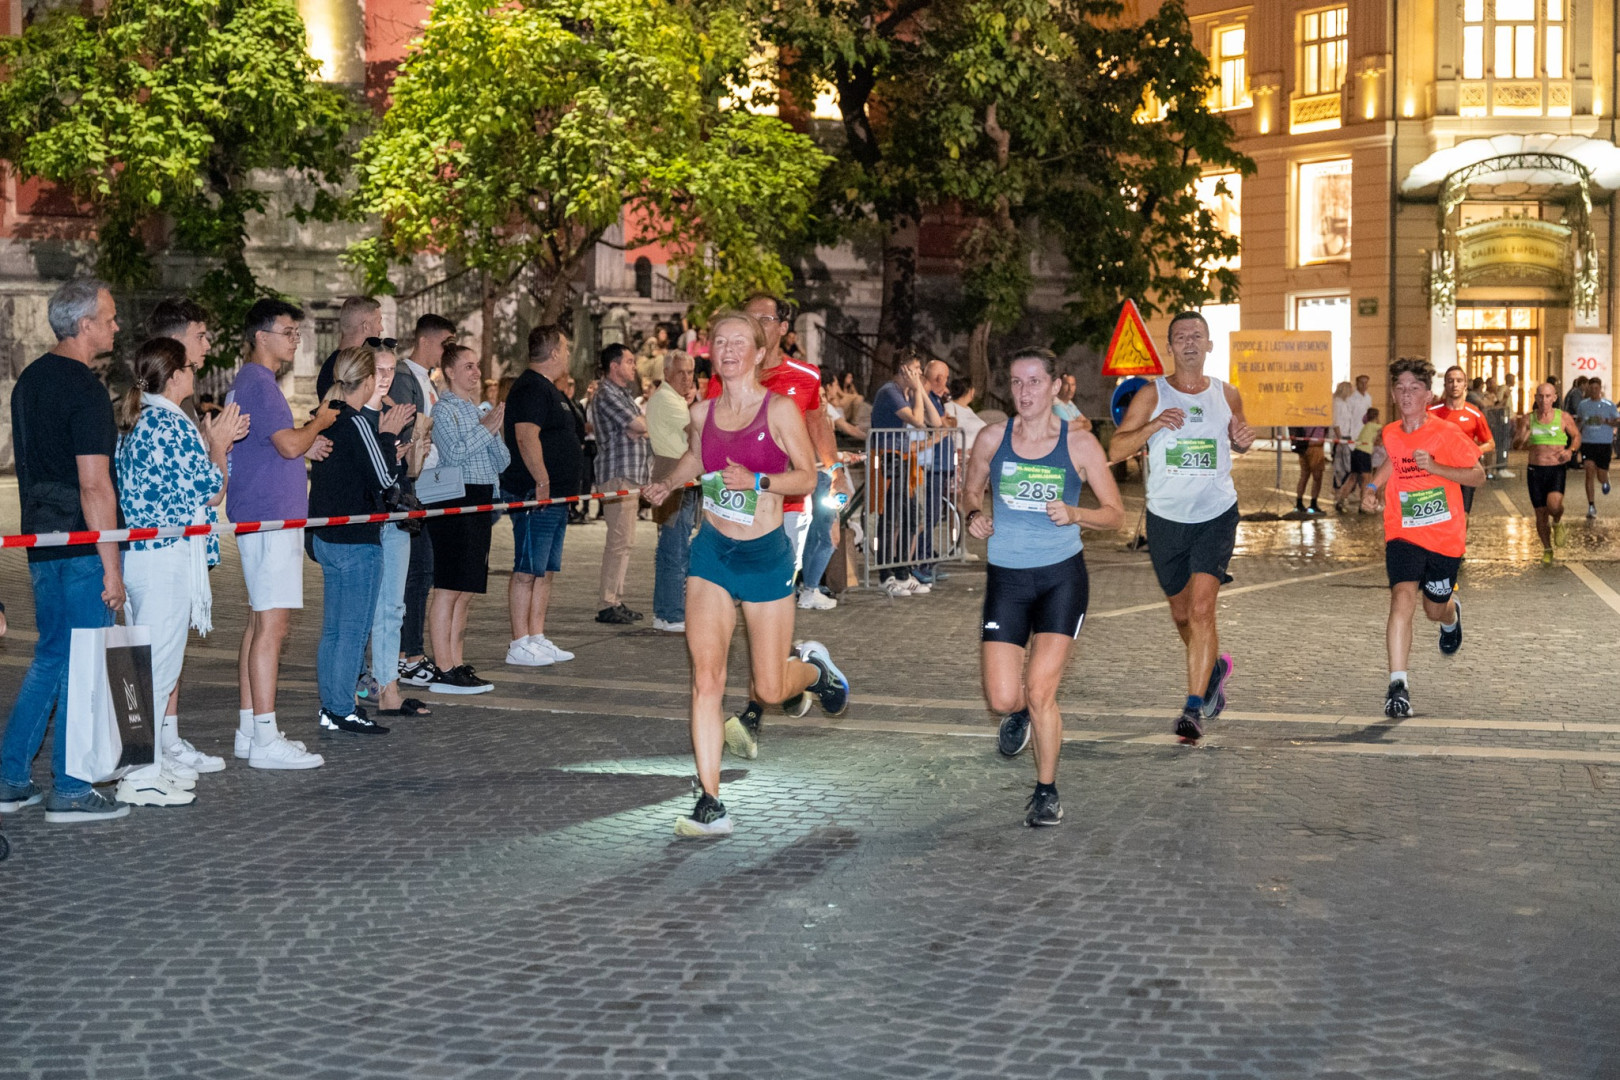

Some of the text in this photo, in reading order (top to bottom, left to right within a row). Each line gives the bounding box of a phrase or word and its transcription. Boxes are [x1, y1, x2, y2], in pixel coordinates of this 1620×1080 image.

[1238, 362, 1248, 372] THE
[1250, 362, 1265, 372] AREA
[1267, 362, 1283, 372] WITH
[1258, 383, 1304, 393] OWN WEATHER
[1182, 452, 1211, 467] 214
[720, 487, 746, 510] 90
[1017, 480, 1057, 501] 285
[1413, 499, 1445, 517] 262
